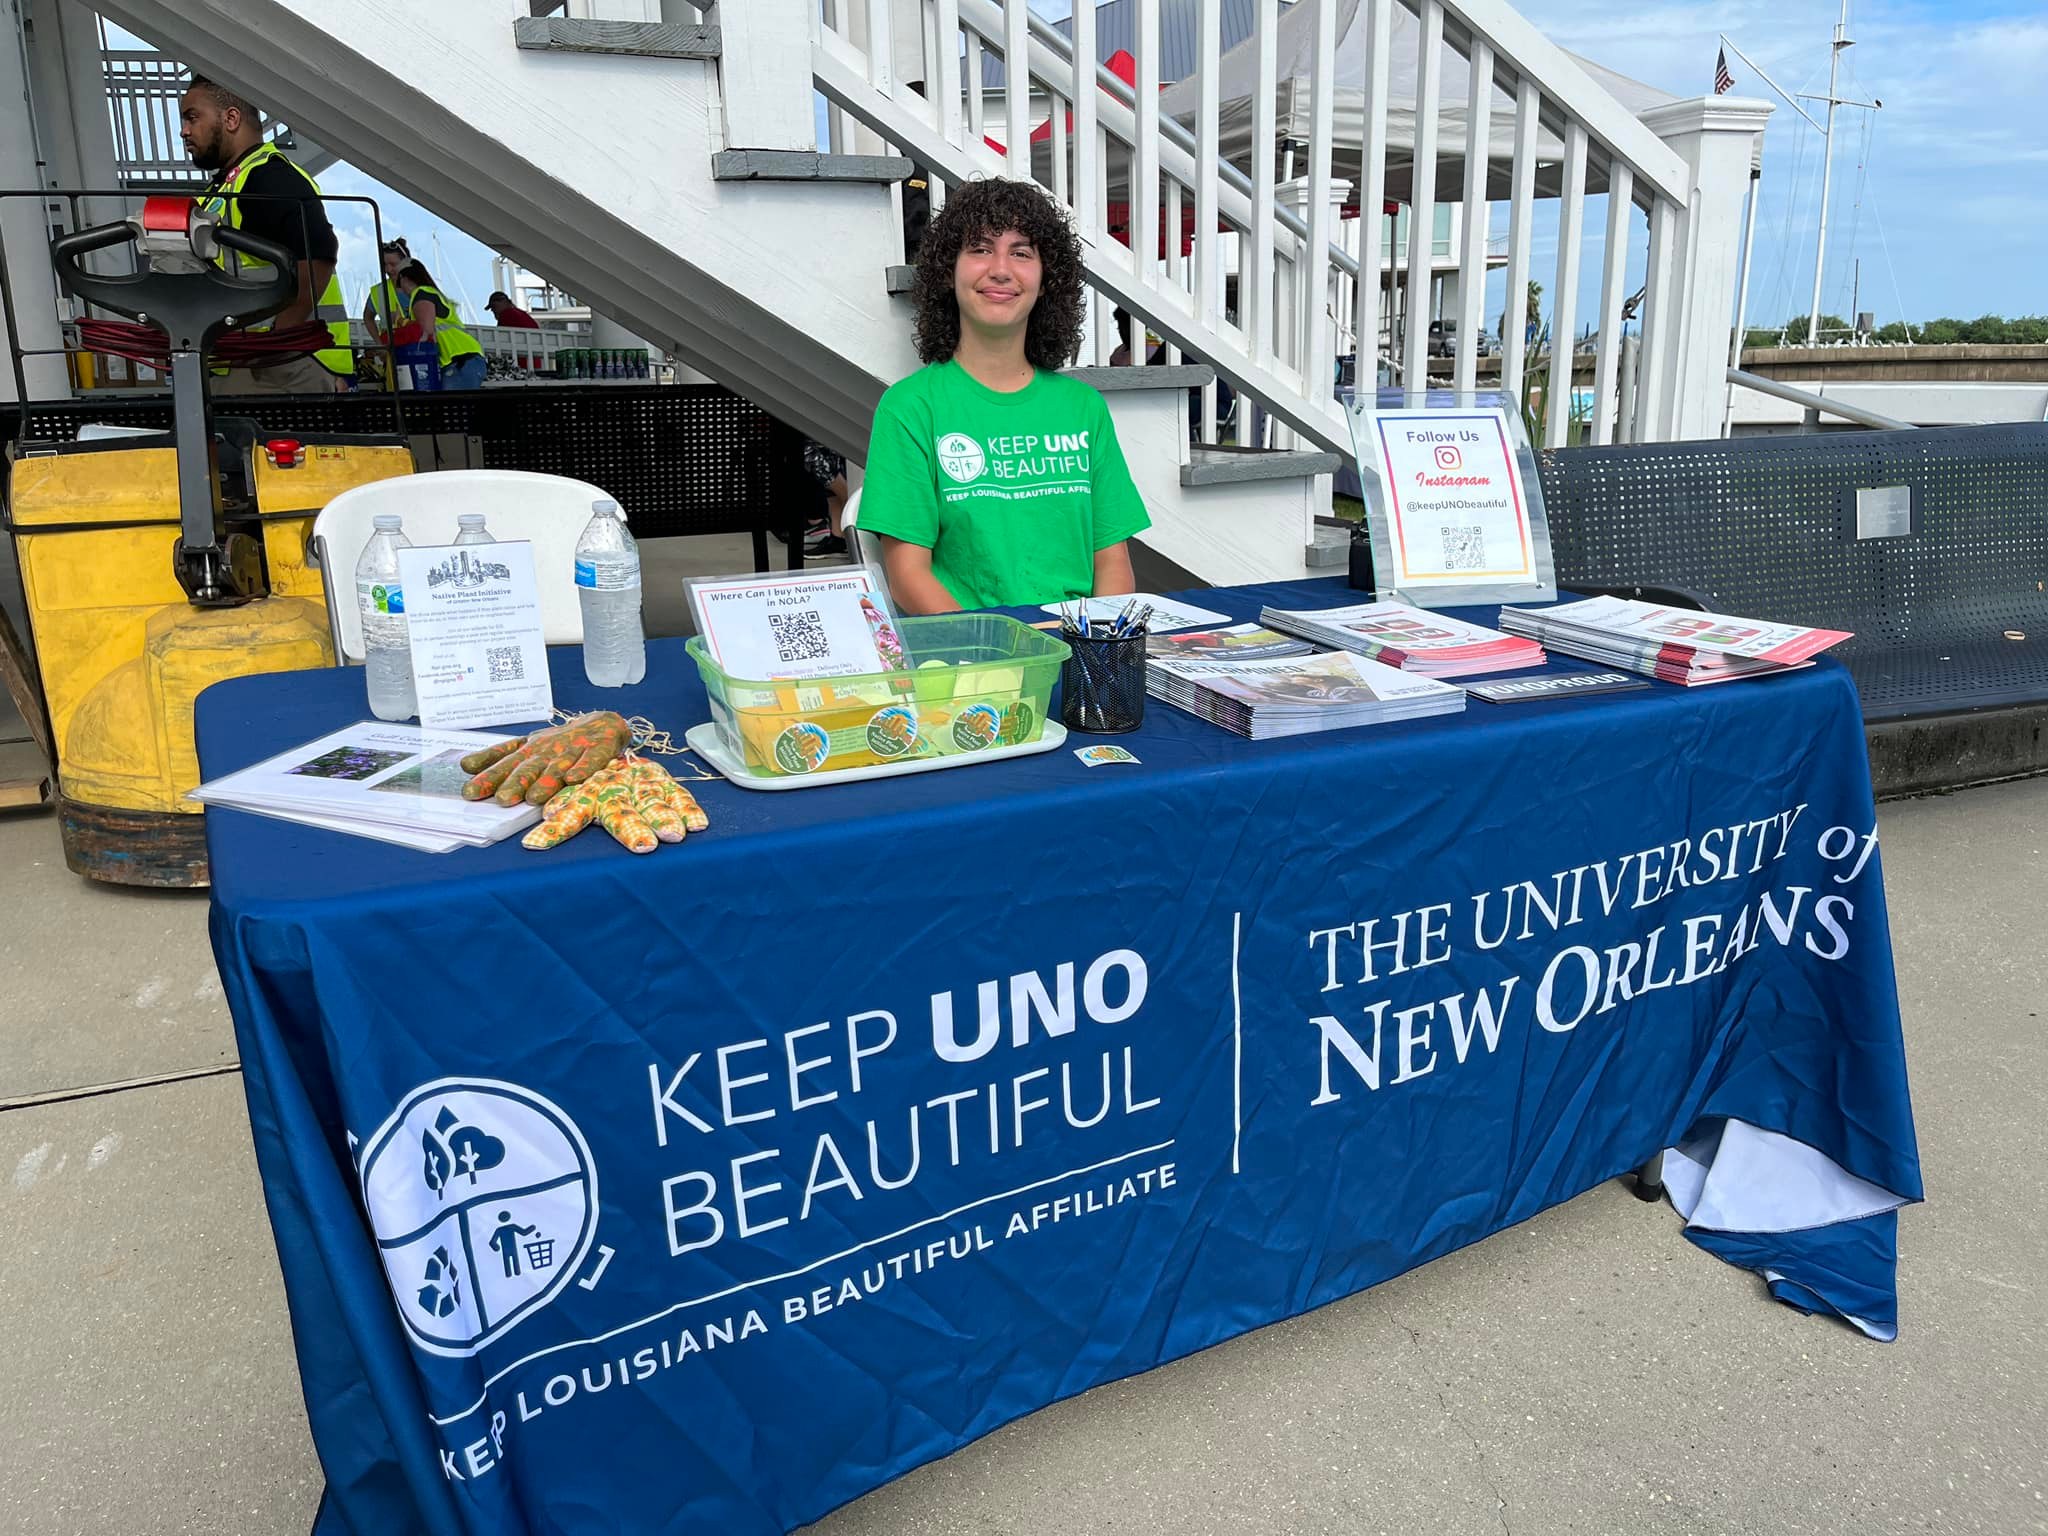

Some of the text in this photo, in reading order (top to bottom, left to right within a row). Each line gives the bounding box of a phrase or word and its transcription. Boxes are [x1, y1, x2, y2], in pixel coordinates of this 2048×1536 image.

[987, 435, 1038, 455] KEEP
[1406, 430, 1480, 443] Follow Us
[992, 455, 1089, 478] BEAUTIFU
[1416, 472, 1491, 488] Instagram
[946, 492, 969, 502] KEEP
[1013, 487, 1066, 500] BEAUTIFUL
[1406, 499, 1508, 513] @keepUNObeautiful
[478, 588, 511, 596] Initiative
[710, 592, 743, 601] Where
[745, 590, 765, 598] Can
[774, 588, 792, 598] buy
[795, 585, 825, 593] Native
[828, 582, 857, 590] Plants
[766, 595, 811, 607] in NOLA?
[1475, 673, 1629, 696] #UNOPROUD
[1309, 803, 1878, 993] THE UNIVERSITY of
[1308, 886, 1854, 1106] NEW ORLEANS
[648, 948, 1148, 1147] KEEP UNO
[661, 1046, 1161, 1257] BEAUTIFUL
[439, 1163, 1177, 1480] KEP LOUISIANA BEAUTIFUL AFFILIATE
